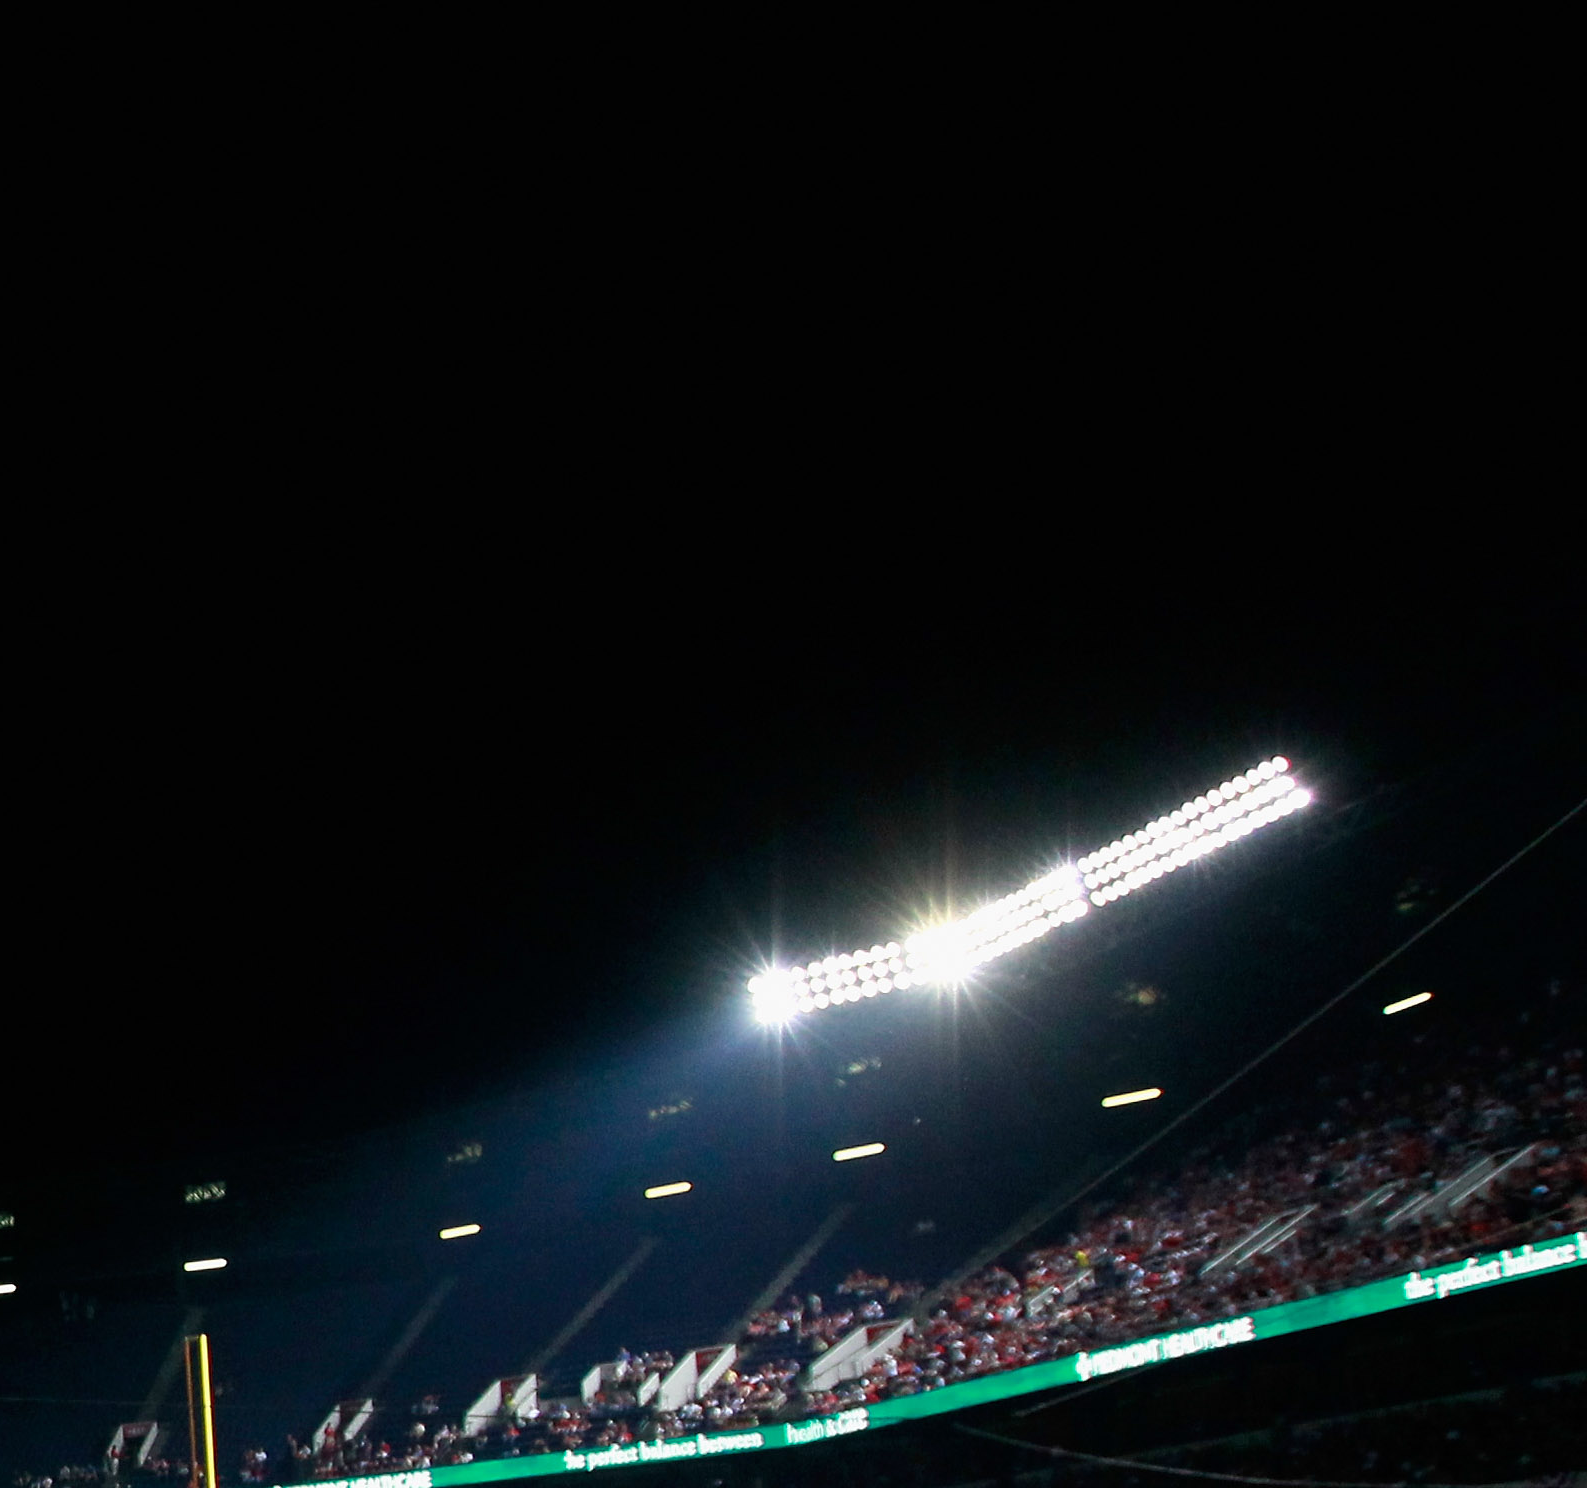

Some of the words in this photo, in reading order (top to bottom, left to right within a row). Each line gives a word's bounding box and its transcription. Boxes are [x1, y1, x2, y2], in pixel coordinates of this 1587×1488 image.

[587, 1443, 639, 1472] perfect
[639, 1439, 696, 1463] balance
[698, 1431, 764, 1456] between
